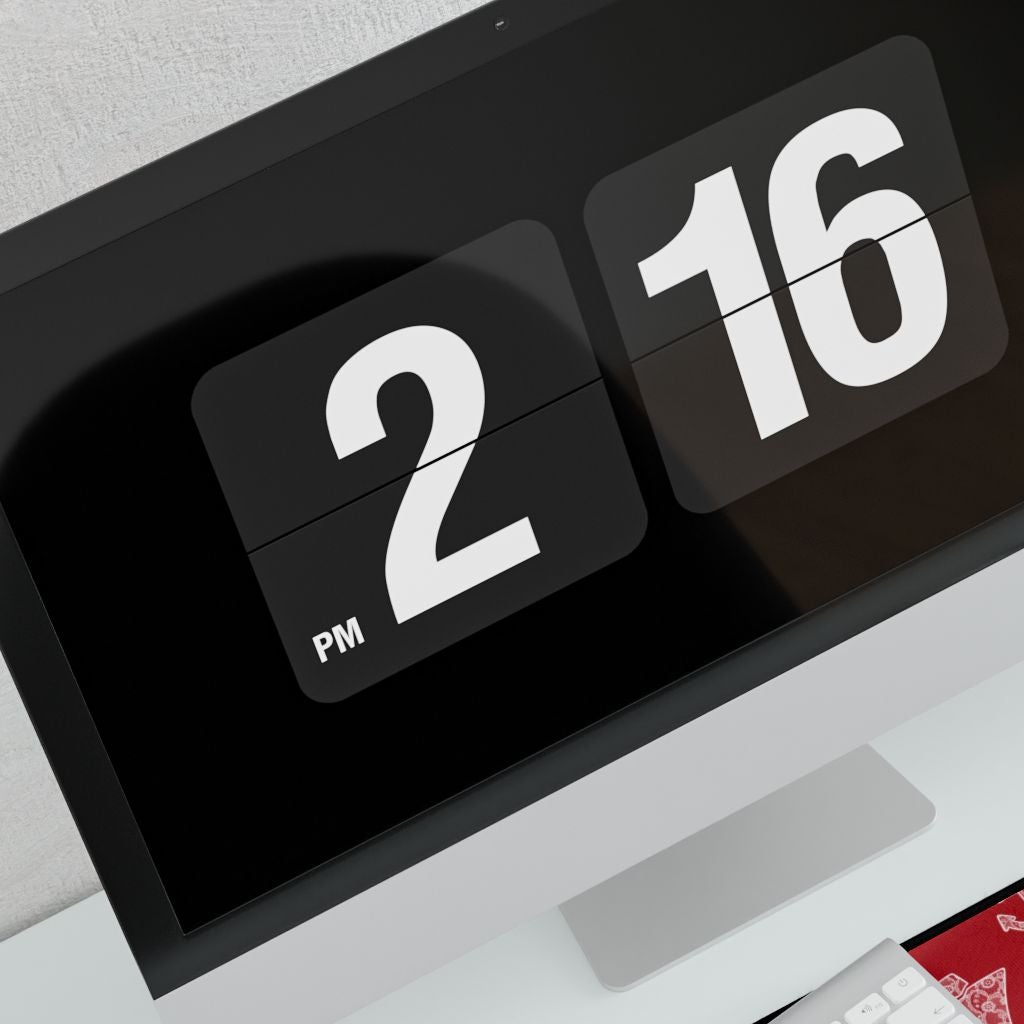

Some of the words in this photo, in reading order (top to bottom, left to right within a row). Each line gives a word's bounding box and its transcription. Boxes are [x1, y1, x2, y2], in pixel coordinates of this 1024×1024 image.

[325, 324, 541, 625] 2
[637, 107, 948, 441] 16
[312, 617, 364, 663] PM
